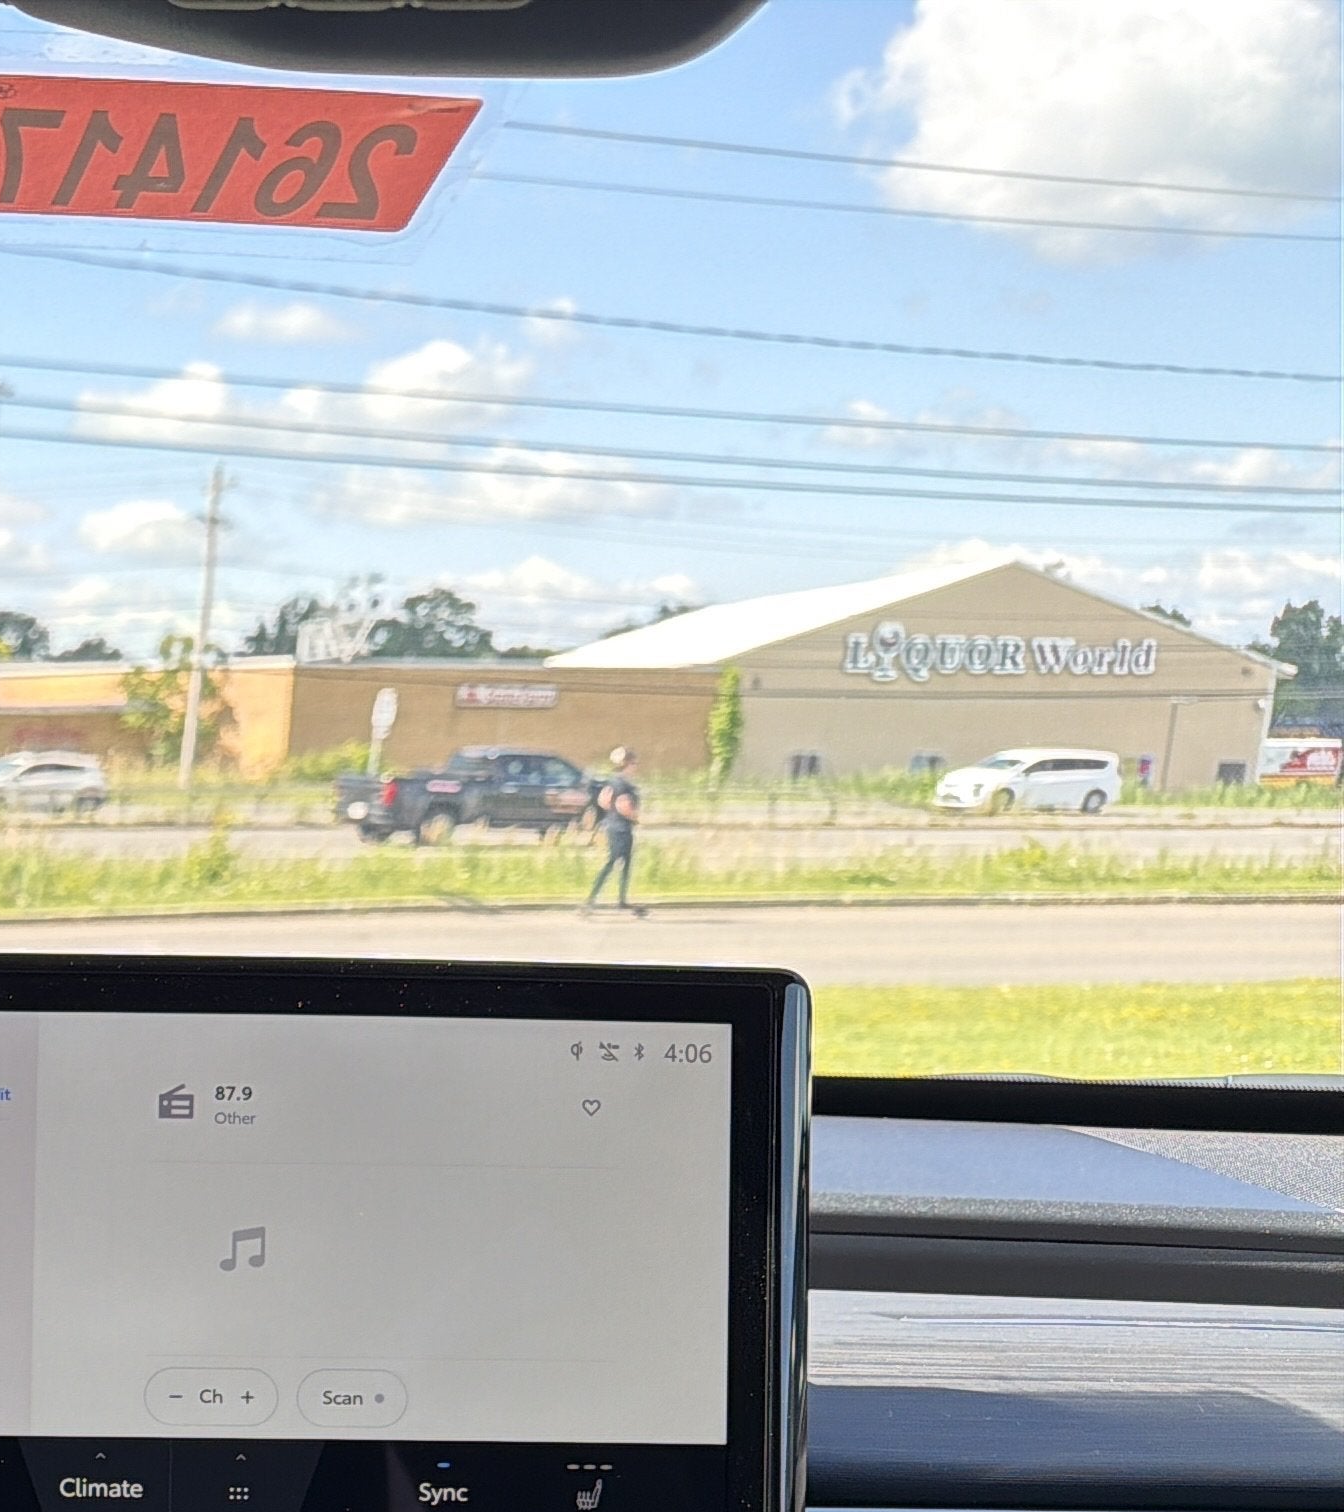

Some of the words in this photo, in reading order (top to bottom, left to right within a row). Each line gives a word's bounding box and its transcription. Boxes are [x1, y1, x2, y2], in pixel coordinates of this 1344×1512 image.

[1032, 638, 1157, 676] World
[664, 1043, 713, 1064] 4:06
[214, 1086, 253, 1101] 87.9
[214, 1111, 255, 1126] Other
[199, 1389, 224, 1405] Ch
[322, 1390, 363, 1406] Scan
[60, 1478, 144, 1499] Climate
[419, 1483, 468, 1506] Sync
